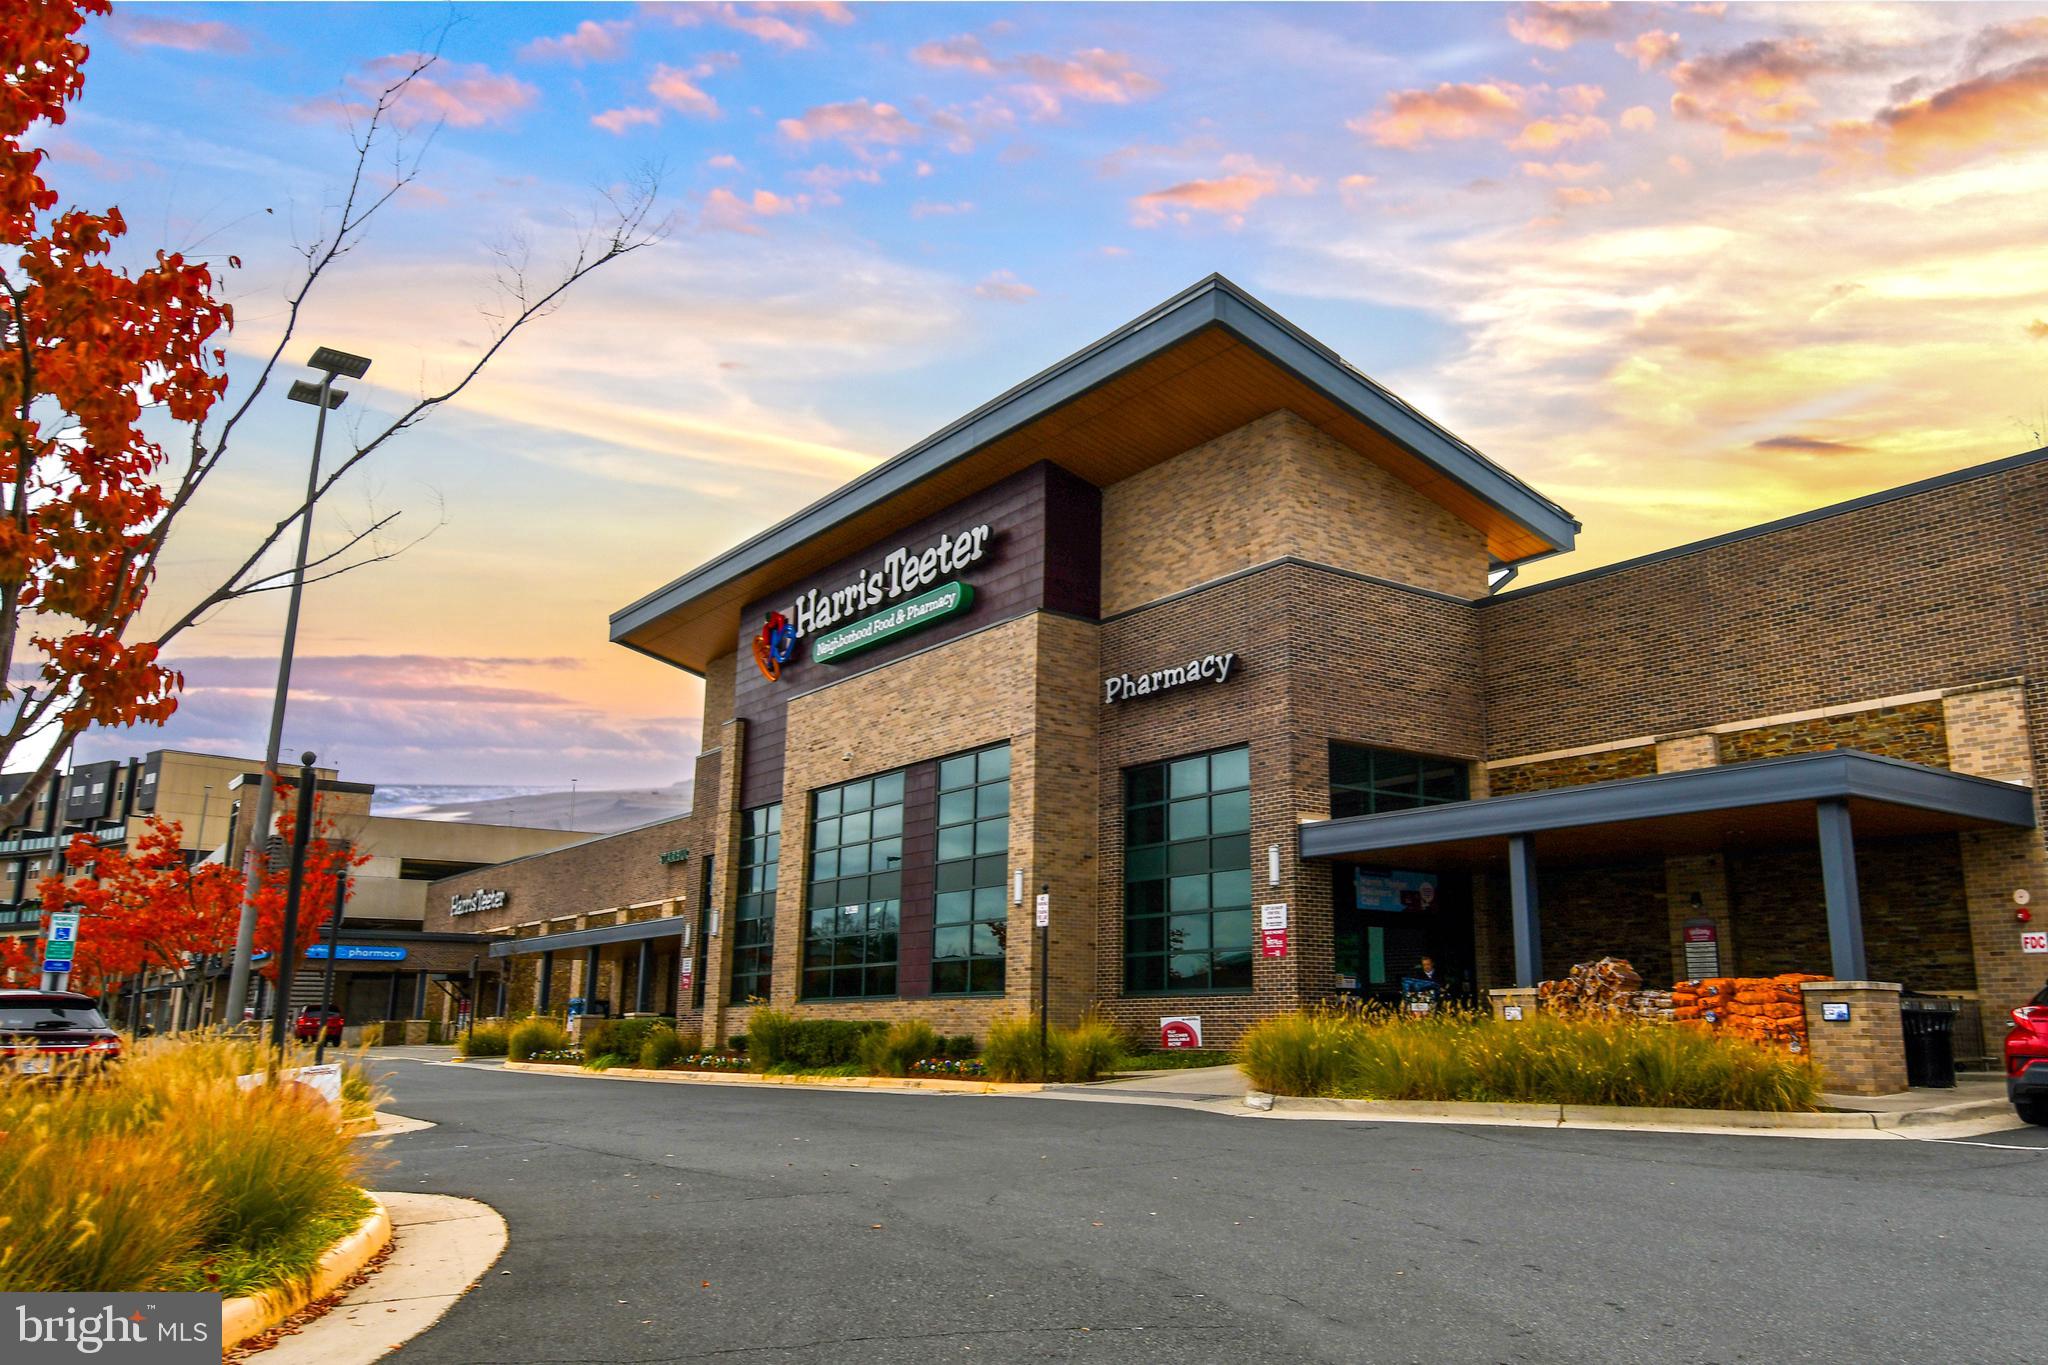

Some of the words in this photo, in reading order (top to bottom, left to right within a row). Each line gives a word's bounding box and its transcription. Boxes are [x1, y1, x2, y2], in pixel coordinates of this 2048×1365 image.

[796, 569, 883, 638] Harris
[884, 524, 990, 599] Teeter
[816, 622, 872, 656] Neighborhood
[873, 613, 895, 633] Food
[895, 609, 906, 625] &
[906, 592, 957, 621] Pharmacy
[1105, 653, 1234, 704] Pharmacy
[349, 947, 402, 959] pharmacy
[2023, 936, 2046, 949] FDC
